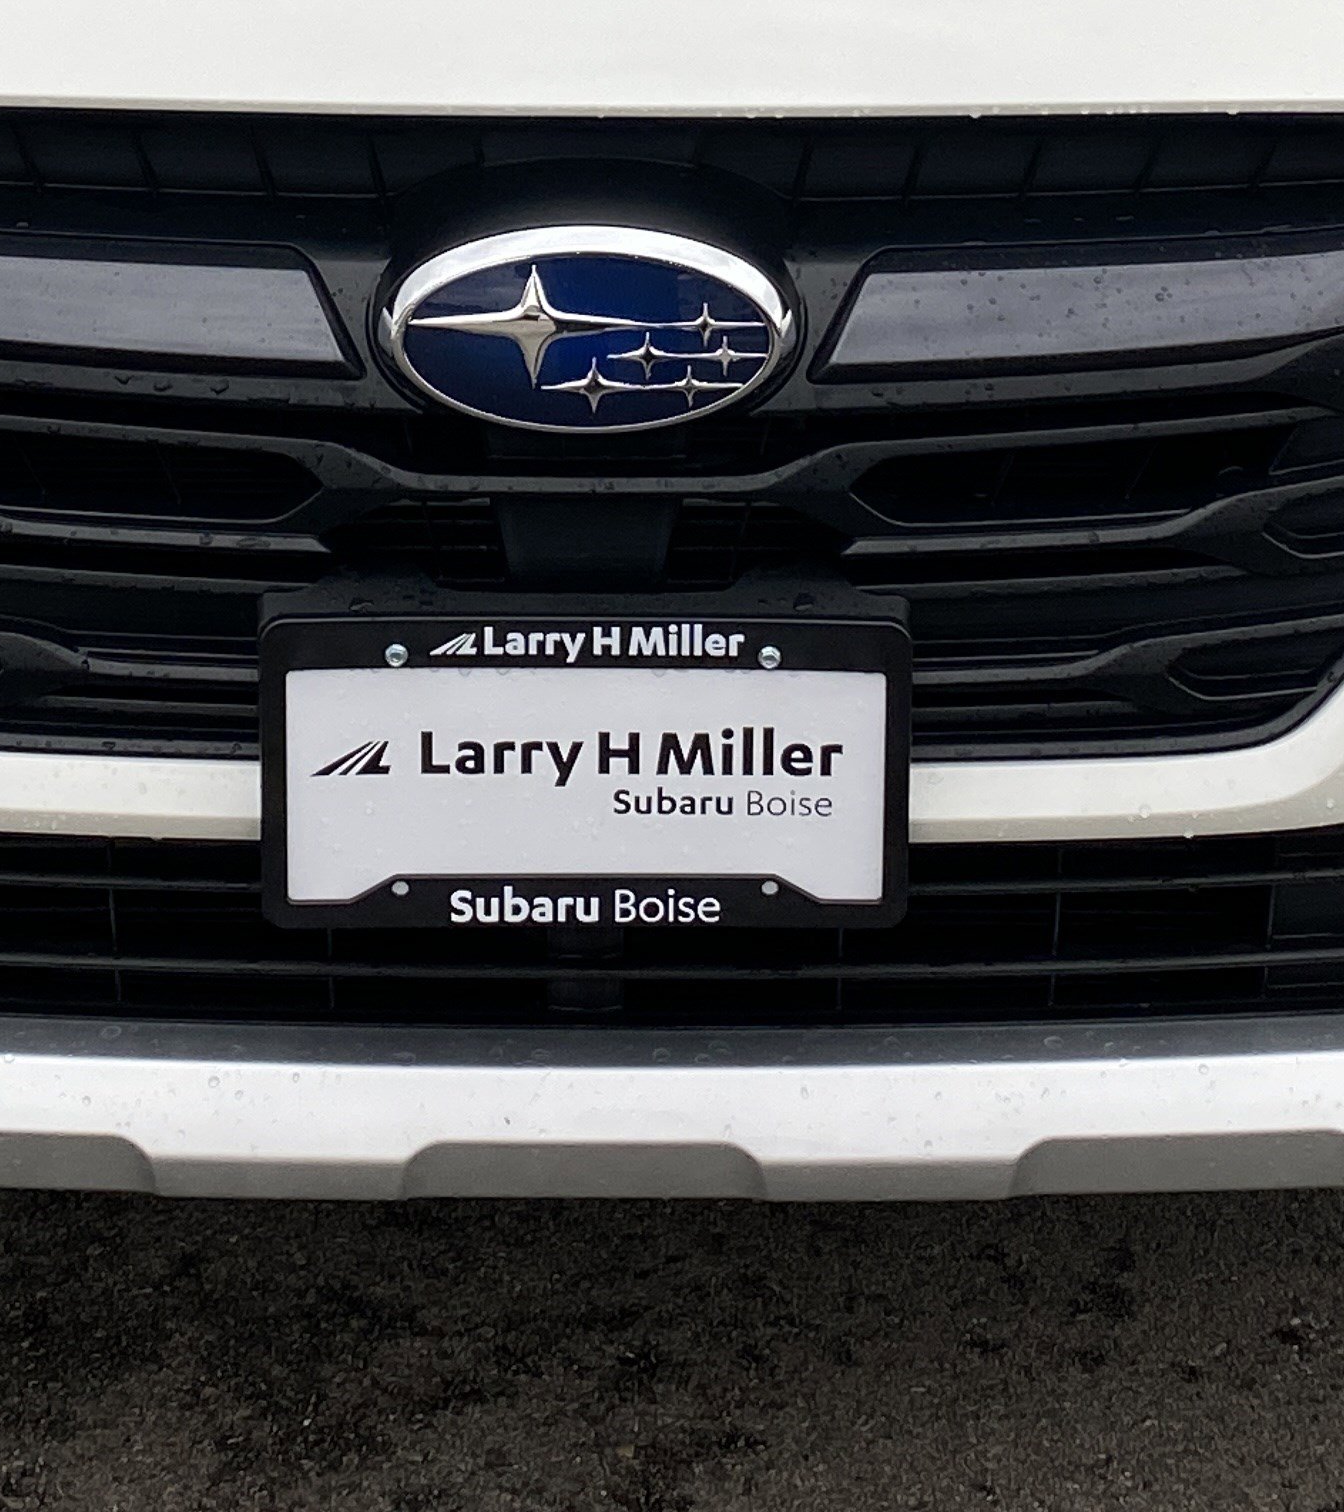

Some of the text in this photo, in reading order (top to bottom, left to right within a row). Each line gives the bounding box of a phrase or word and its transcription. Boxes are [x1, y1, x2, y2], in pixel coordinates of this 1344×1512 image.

[483, 623, 745, 663] Larry H Miller
[420, 726, 844, 787] Larry H Miller
[613, 787, 833, 817] Subaru Boise
[450, 885, 721, 923] Subaru Boise
